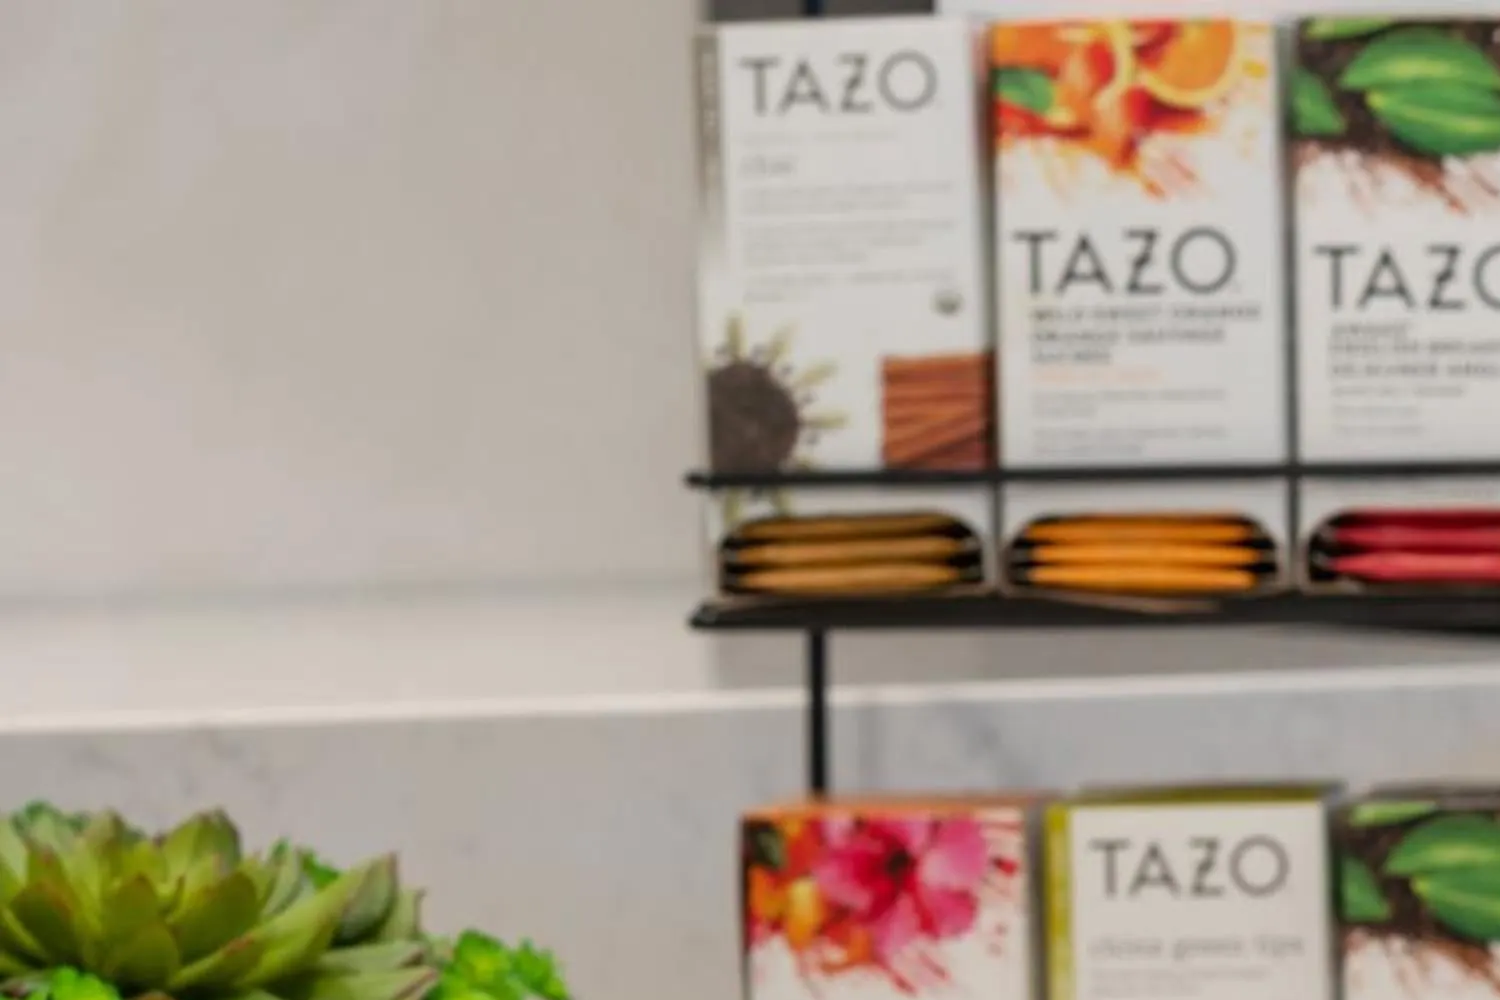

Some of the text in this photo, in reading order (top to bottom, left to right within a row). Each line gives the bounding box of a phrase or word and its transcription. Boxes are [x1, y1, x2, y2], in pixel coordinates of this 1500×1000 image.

[738, 50, 938, 116] TAZO
[1013, 225, 1238, 296] TAZO
[1088, 832, 1290, 899] TAZO
